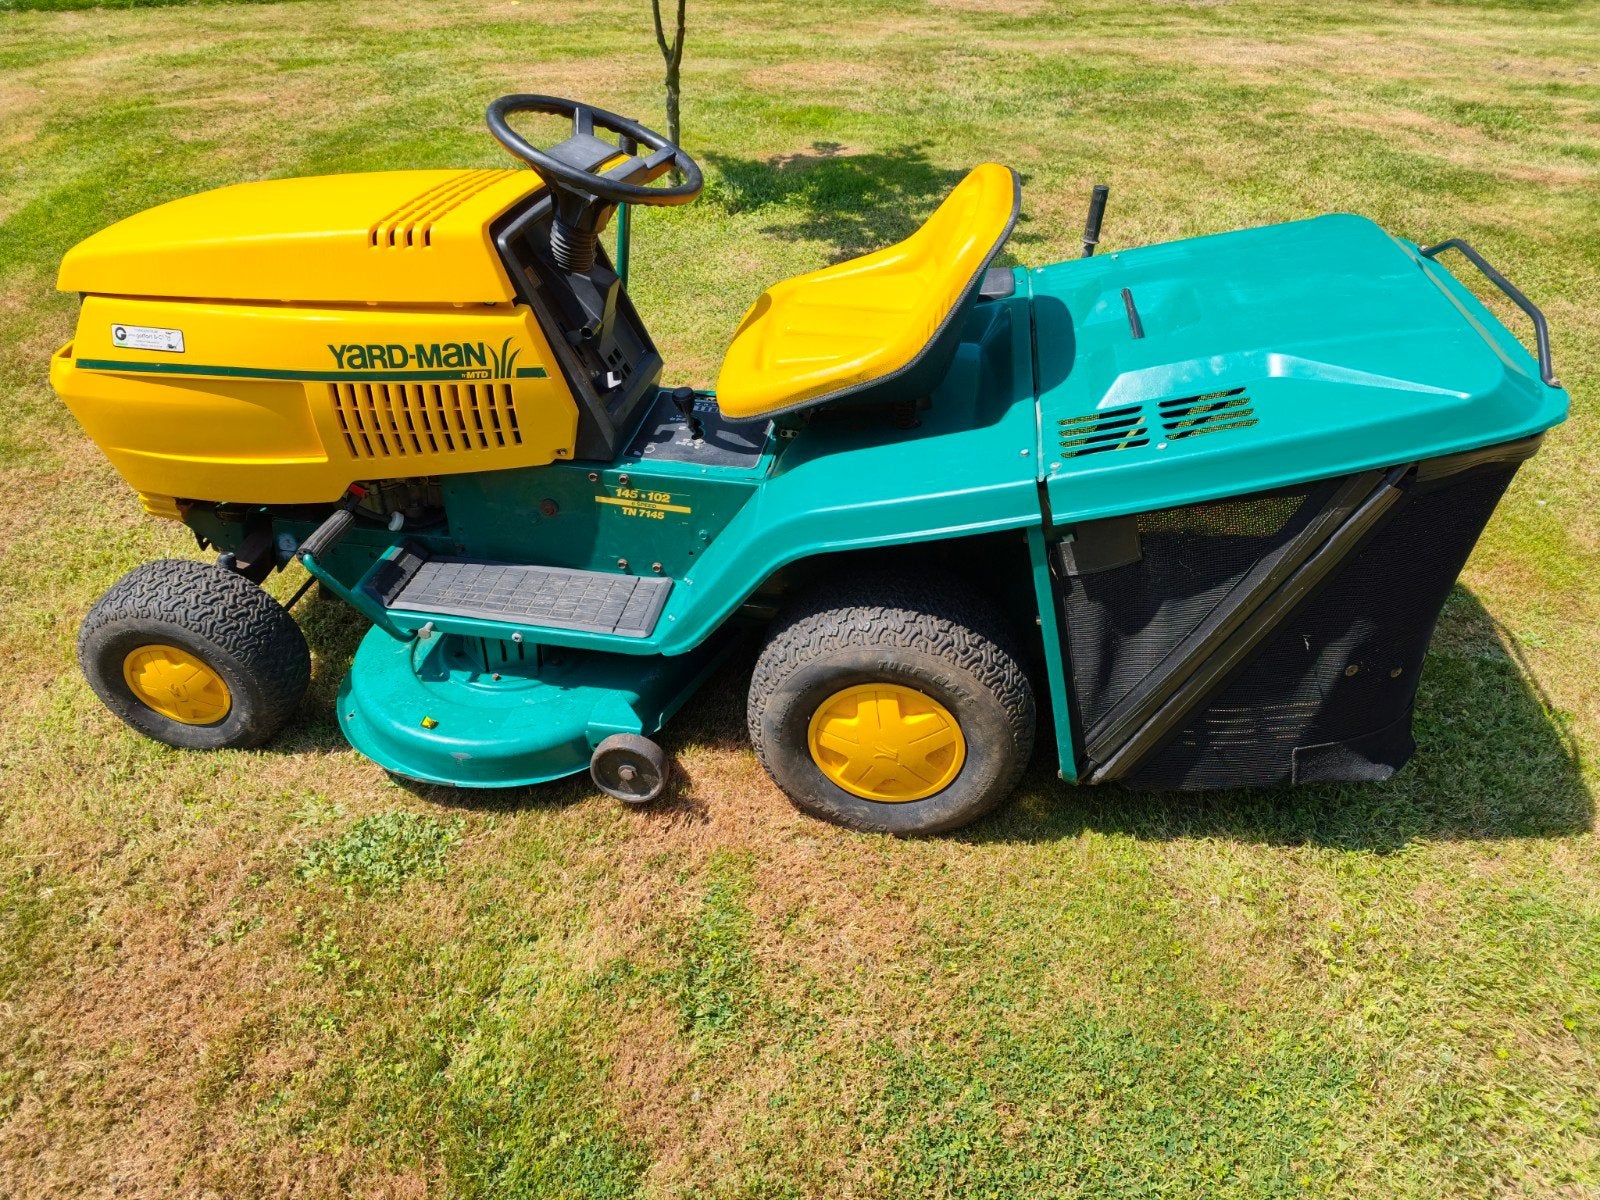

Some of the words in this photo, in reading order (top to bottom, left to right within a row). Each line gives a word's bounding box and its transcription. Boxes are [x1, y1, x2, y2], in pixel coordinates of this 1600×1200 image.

[616, 488, 638, 499] 145
[648, 492, 671, 503] 102
[622, 507, 637, 516] TN
[639, 509, 665, 519] 7145
